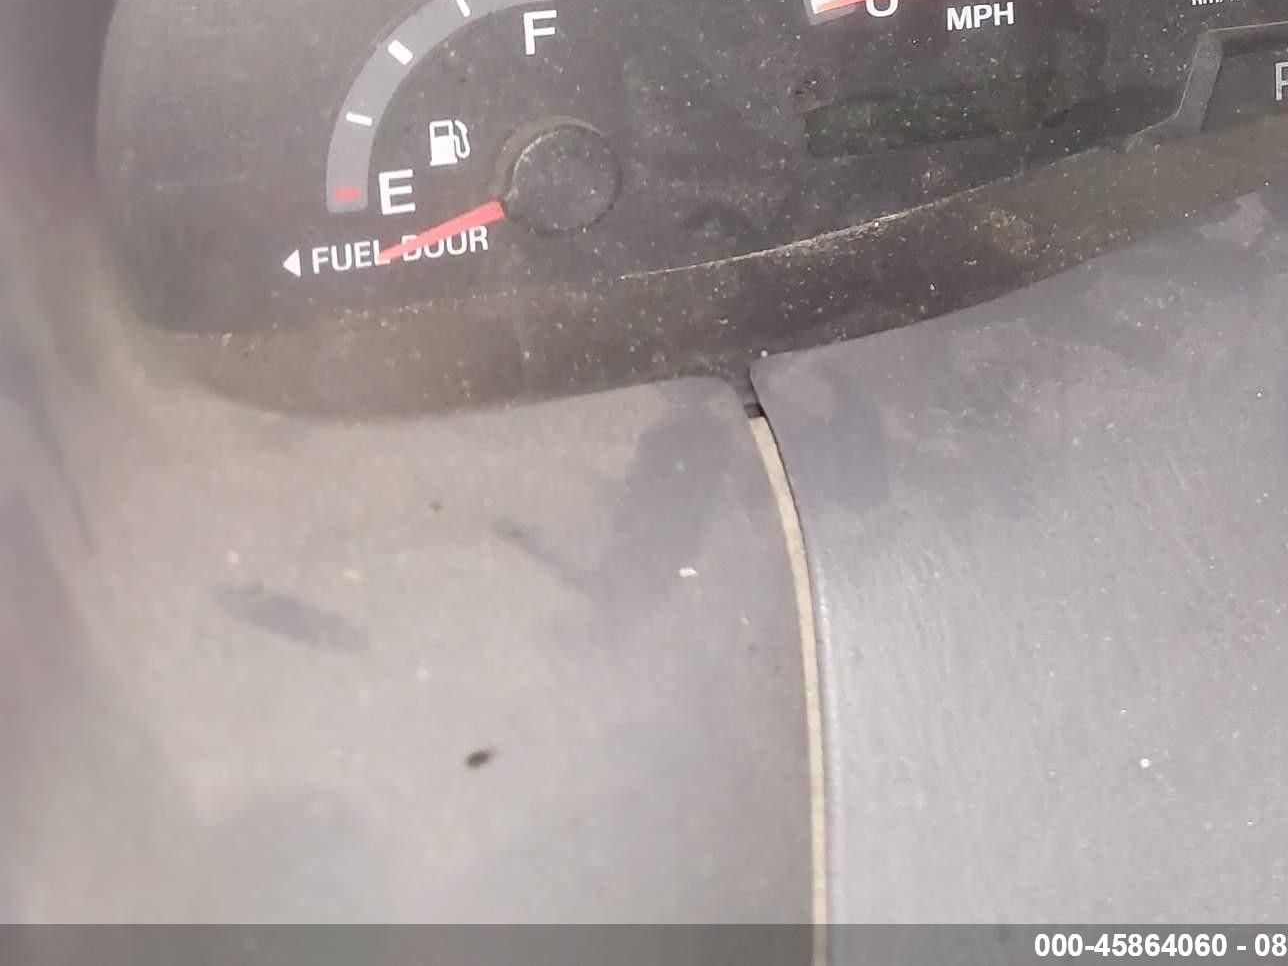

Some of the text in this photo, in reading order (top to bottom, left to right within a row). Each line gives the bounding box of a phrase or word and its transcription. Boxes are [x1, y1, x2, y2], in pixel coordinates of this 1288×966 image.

[522, 9, 558, 56] F
[945, 0, 1016, 33] MPH
[377, 167, 418, 217] E
[310, 237, 392, 276] FUEL
